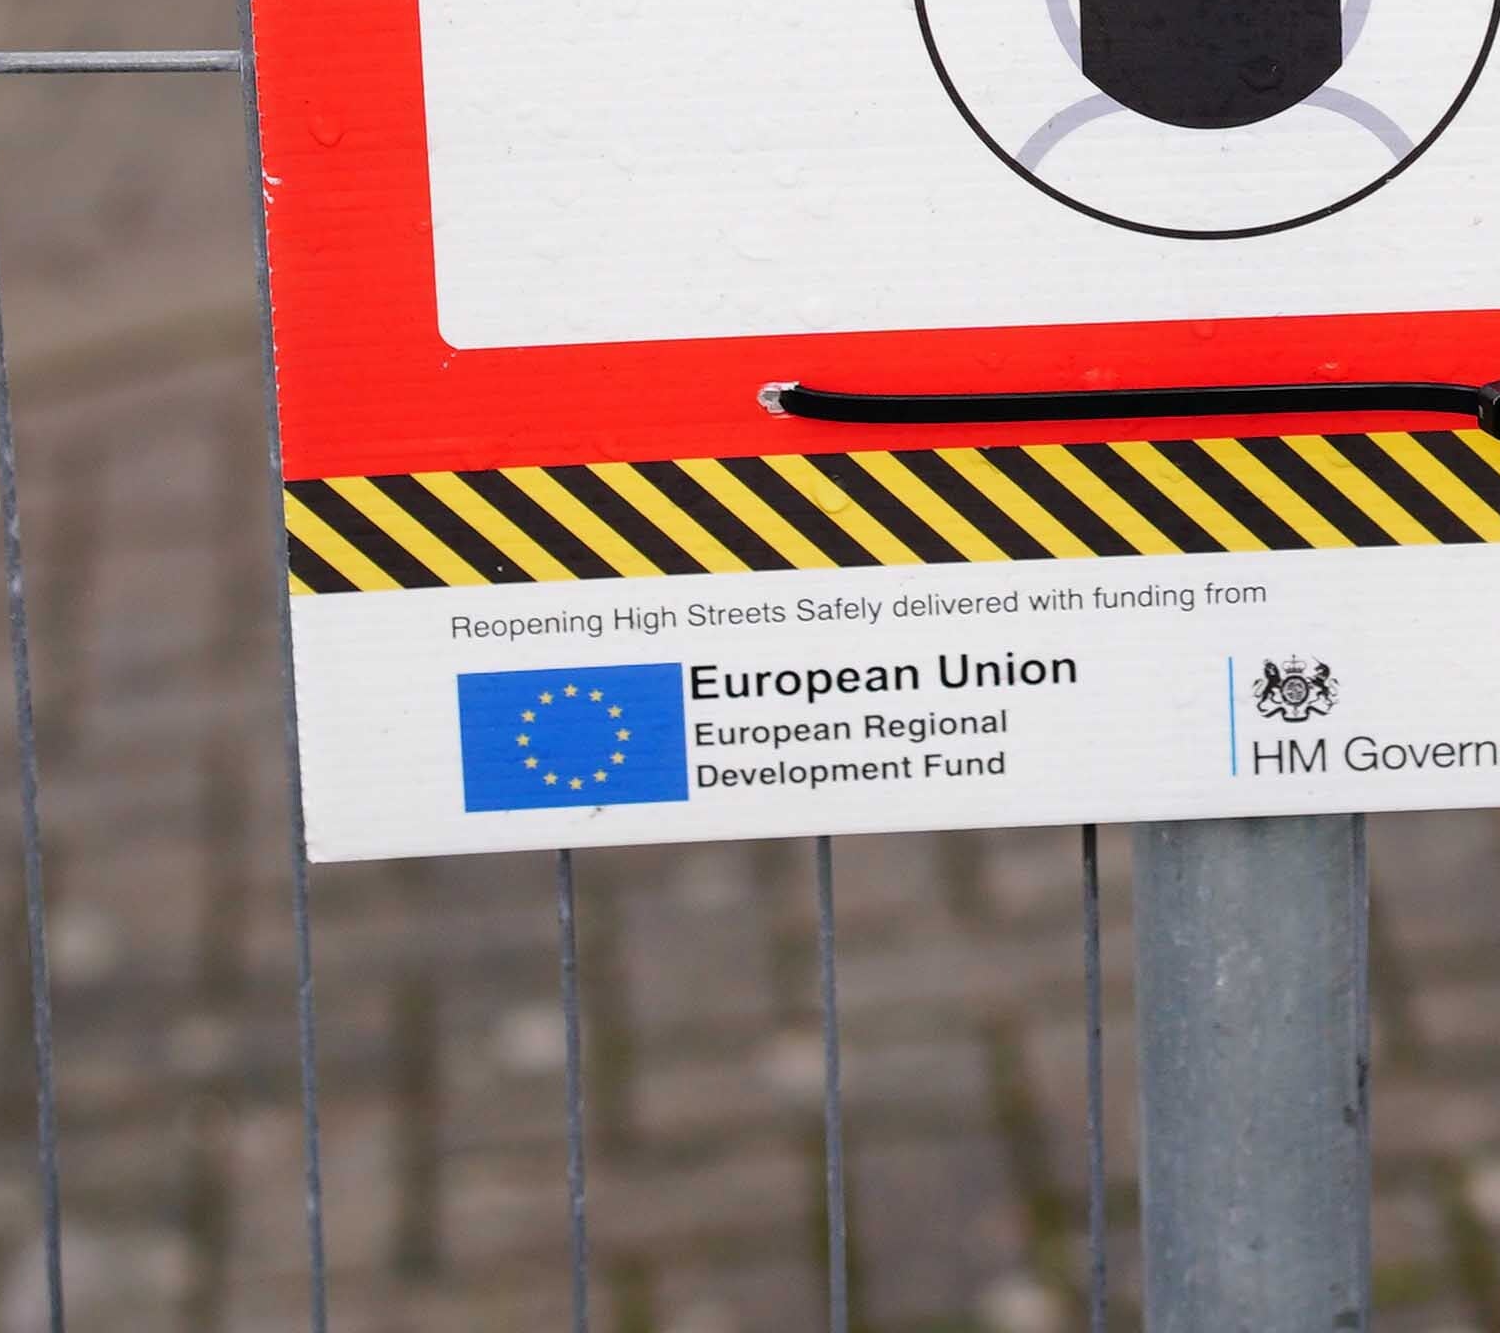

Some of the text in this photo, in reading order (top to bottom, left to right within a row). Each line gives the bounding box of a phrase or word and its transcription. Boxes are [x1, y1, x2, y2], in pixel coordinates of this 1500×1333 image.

[451, 581, 1267, 642] Reopening High Streets Safely delivered with funding from
[690, 652, 1078, 704] European Union
[695, 709, 1008, 749] European Regional
[697, 751, 1005, 790] Development Fund
[1253, 738, 1327, 775] HM
